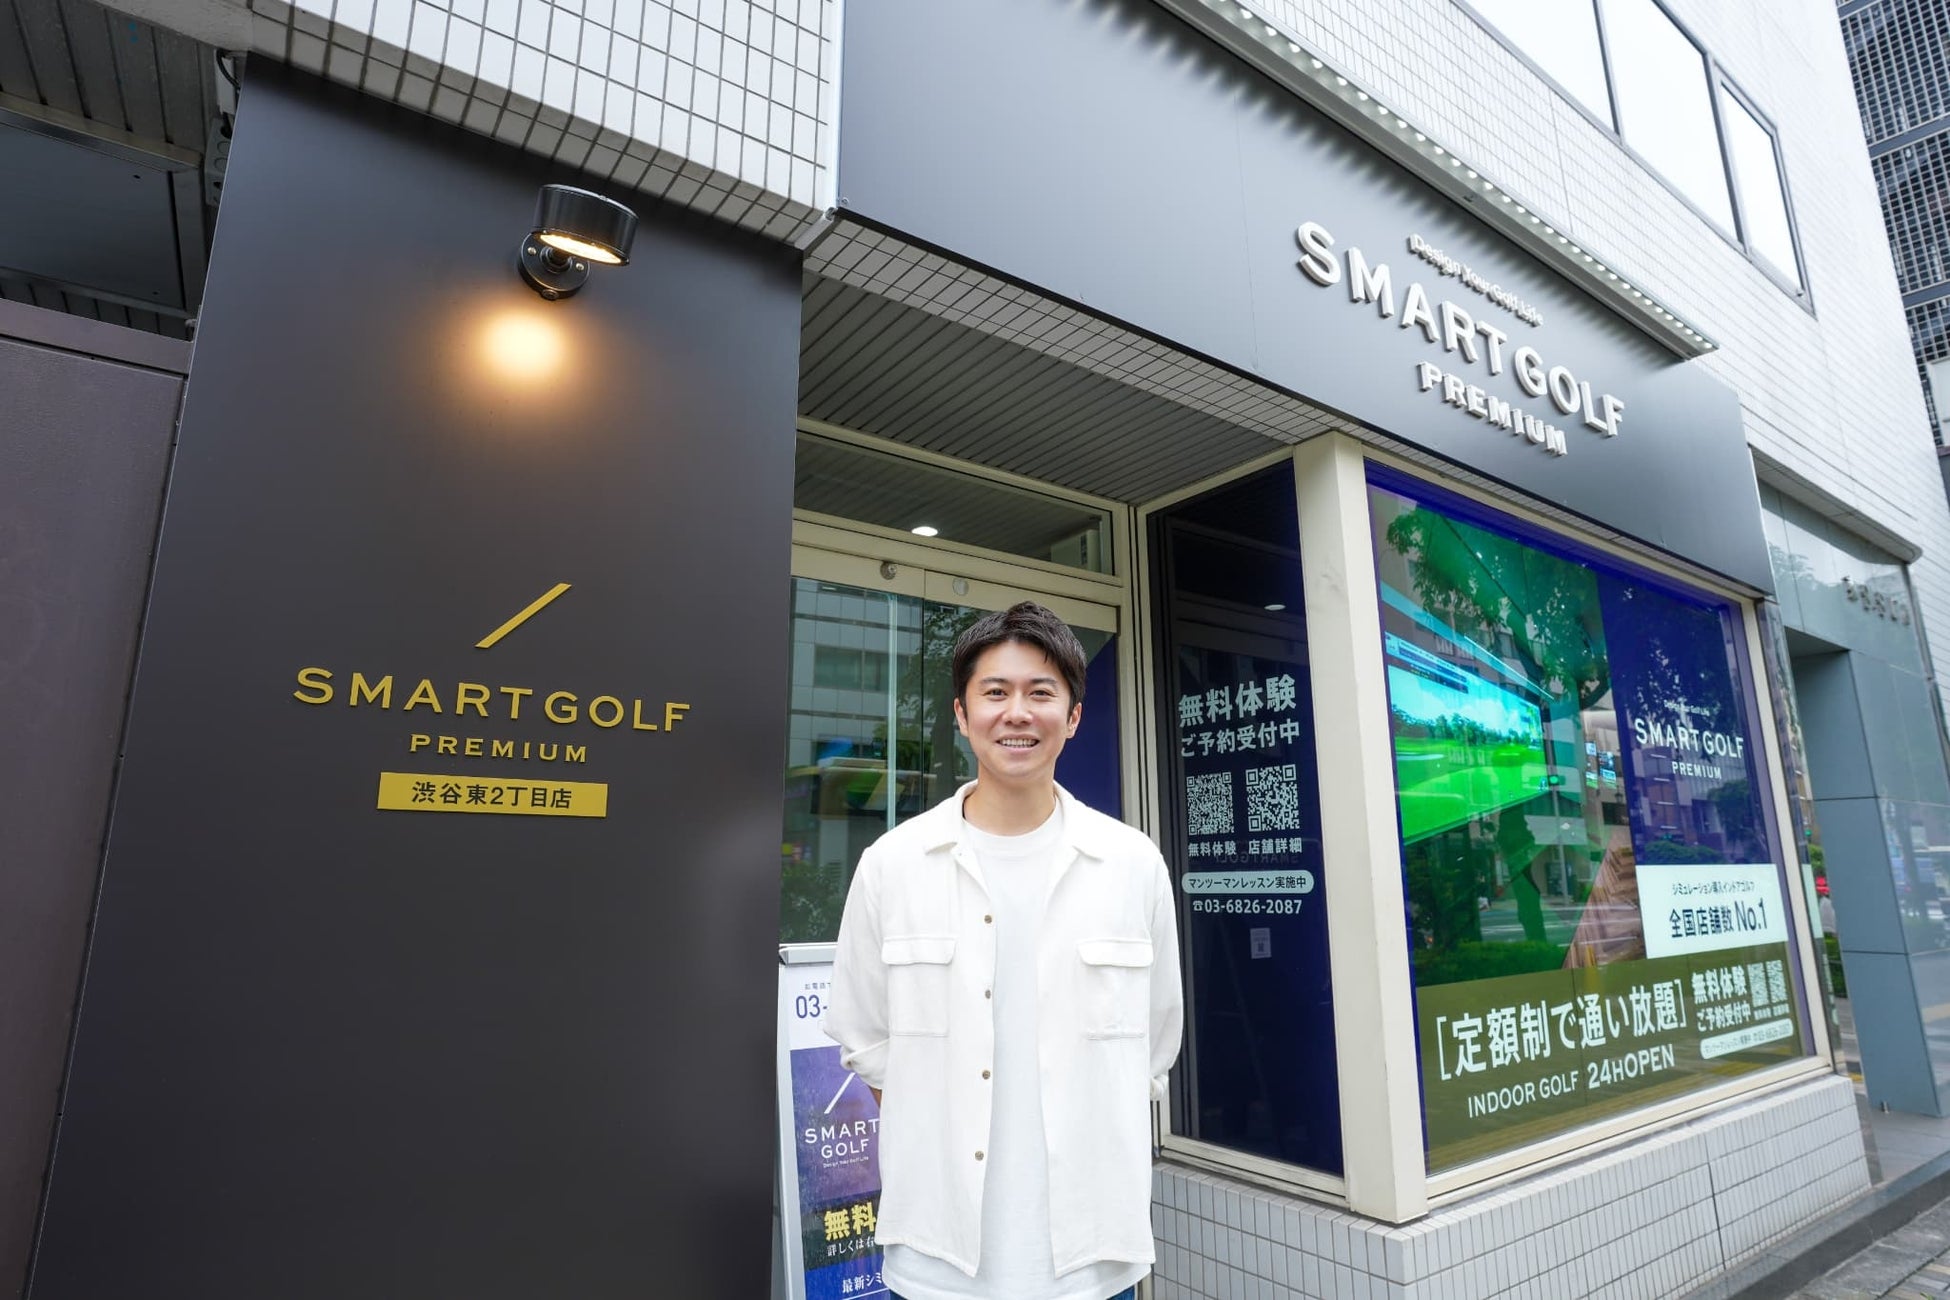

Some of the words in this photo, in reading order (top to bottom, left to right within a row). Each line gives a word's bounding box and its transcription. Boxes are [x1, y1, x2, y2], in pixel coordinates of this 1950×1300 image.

[1297, 221, 1508, 376] SMART
[1513, 345, 1625, 438] GOLF
[1416, 361, 1569, 457] PREMIUM
[293, 667, 533, 719] SMART
[544, 691, 690, 732] GOLF
[1178, 674, 1297, 728] 無料体験
[409, 734, 588, 763] PREMIUM
[1180, 718, 1300, 758] ご予約受付中
[1634, 718, 1700, 752] SMART
[1702, 730, 1744, 759] GOLF
[1671, 761, 1722, 780] PREMIUM
[411, 780, 572, 810] 渋谷東2丁目店
[1188, 840, 1237, 857] 無料体験
[1248, 837, 1303, 855] 店舗詳細
[1188, 875, 1307, 889] マンツーマンレッスン実施中
[1204, 899, 1303, 914] 03-6826-2087
[1468, 1081, 1536, 1118] INDOOR
[1539, 1070, 1579, 1100] GOLF
[805, 1118, 880, 1144] SMART
[821, 1138, 869, 1159] GOLF
[824, 1202, 877, 1241] 無料
